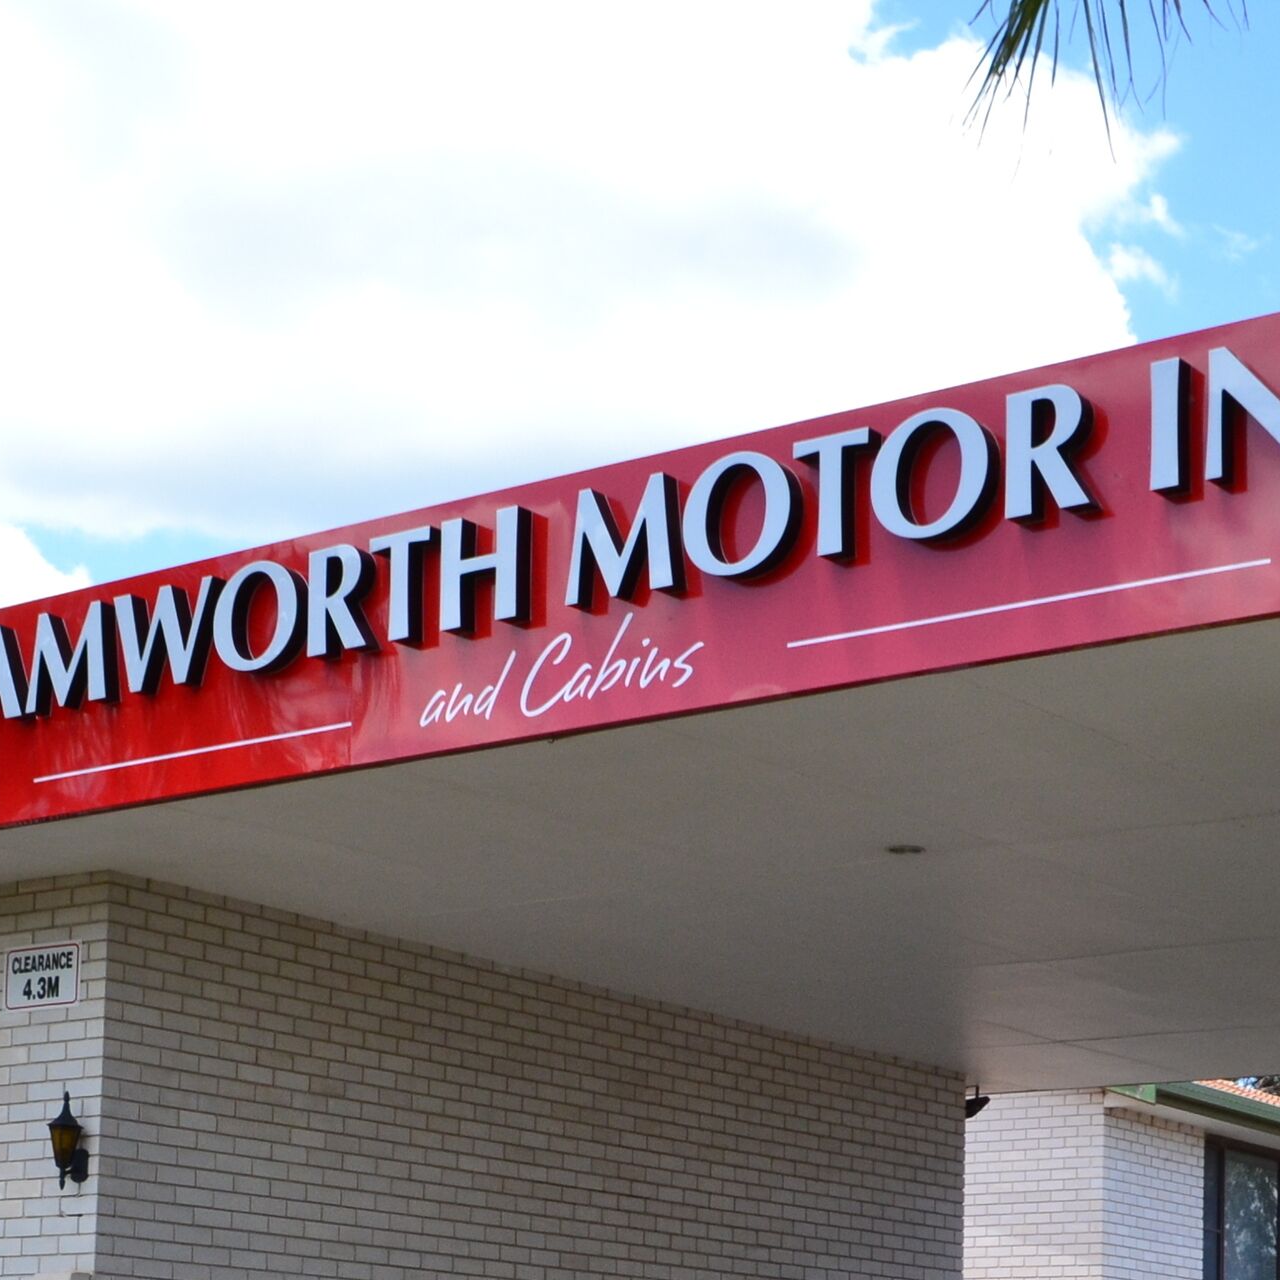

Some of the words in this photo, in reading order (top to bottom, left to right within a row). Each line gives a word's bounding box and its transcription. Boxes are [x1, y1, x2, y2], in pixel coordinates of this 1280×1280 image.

[564, 383, 1097, 608] MOTOR
[419, 649, 517, 728] and
[520, 611, 705, 718] Cabins
[11, 951, 74, 975] CLEARANCE
[22, 975, 60, 1001] 4.3M
